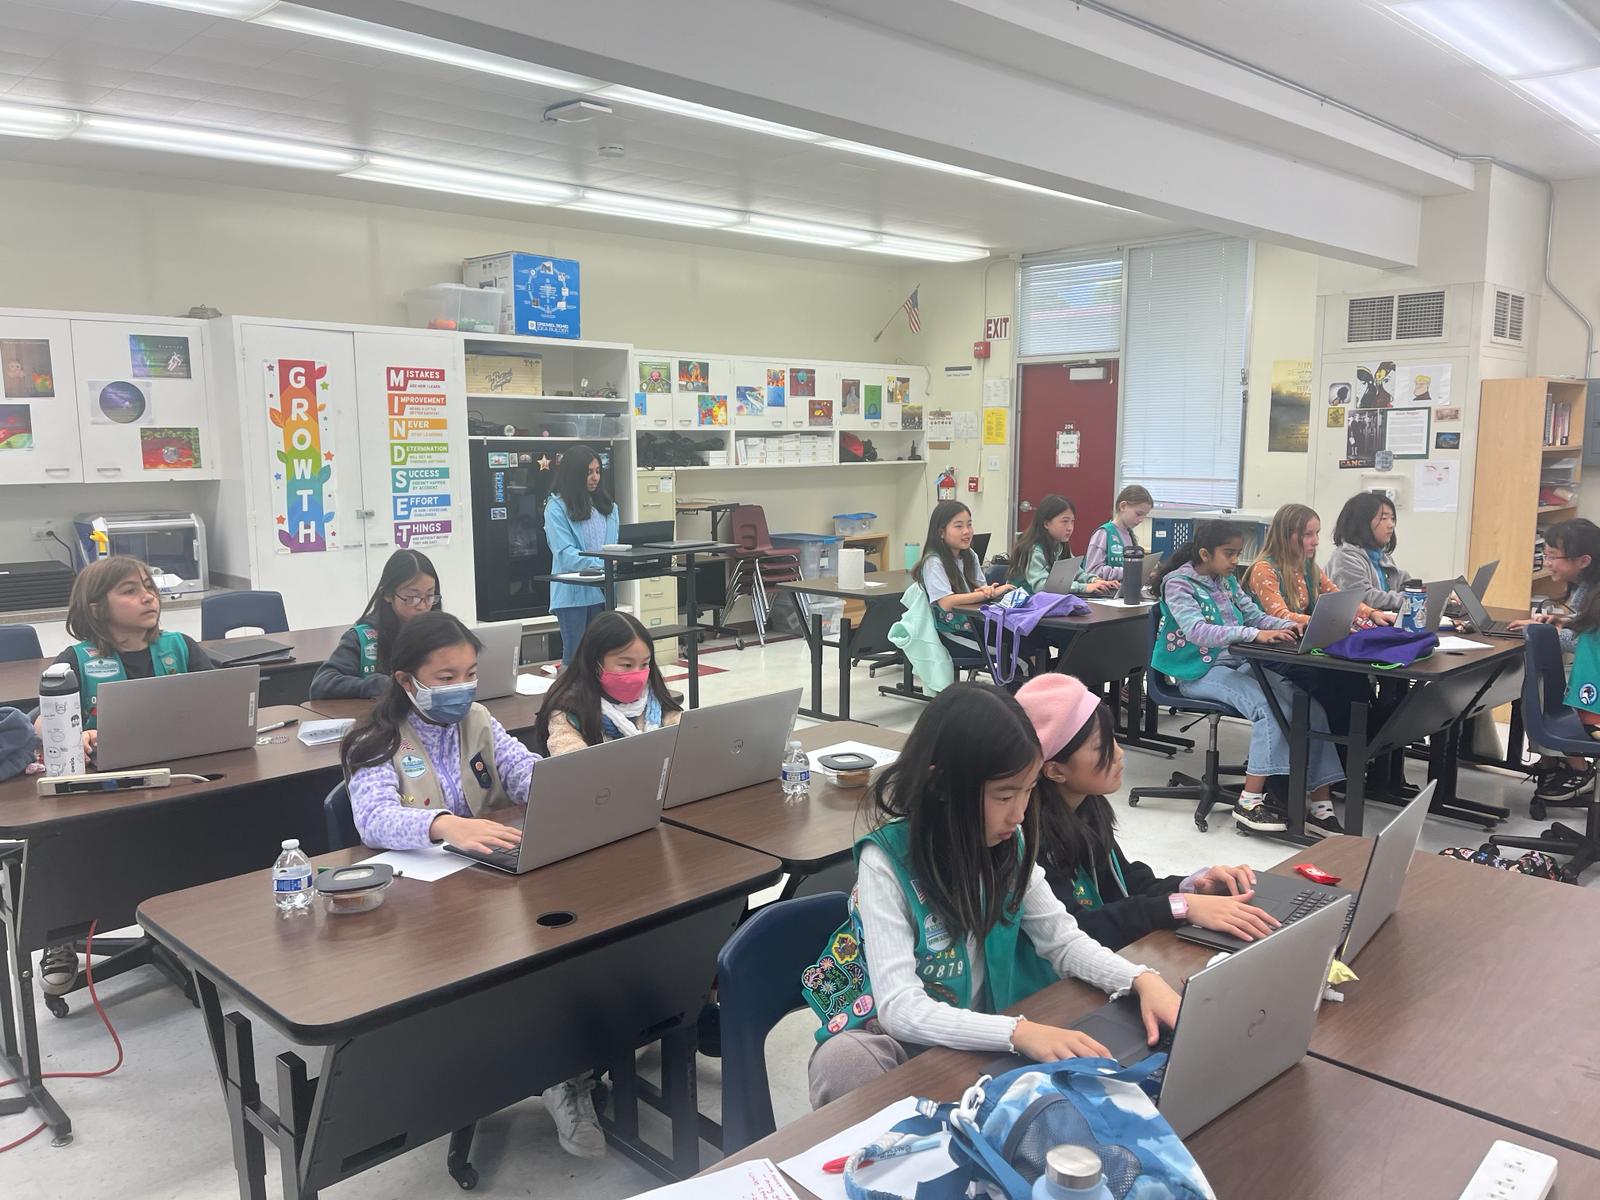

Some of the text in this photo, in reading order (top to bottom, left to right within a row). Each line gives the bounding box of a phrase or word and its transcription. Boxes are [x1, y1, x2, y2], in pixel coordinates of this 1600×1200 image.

[987, 317, 1009, 339] EXIT
[390, 369, 440, 387] MISTAKES
[393, 395, 445, 414] IMPROVEMENT
[393, 419, 429, 438] NEVER
[288, 367, 316, 544] GROWTH
[393, 445, 448, 462] DETERMINATION
[395, 469, 440, 488] SUCCESS
[396, 496, 439, 516] EFFORT
[398, 522, 441, 543] THINGS
